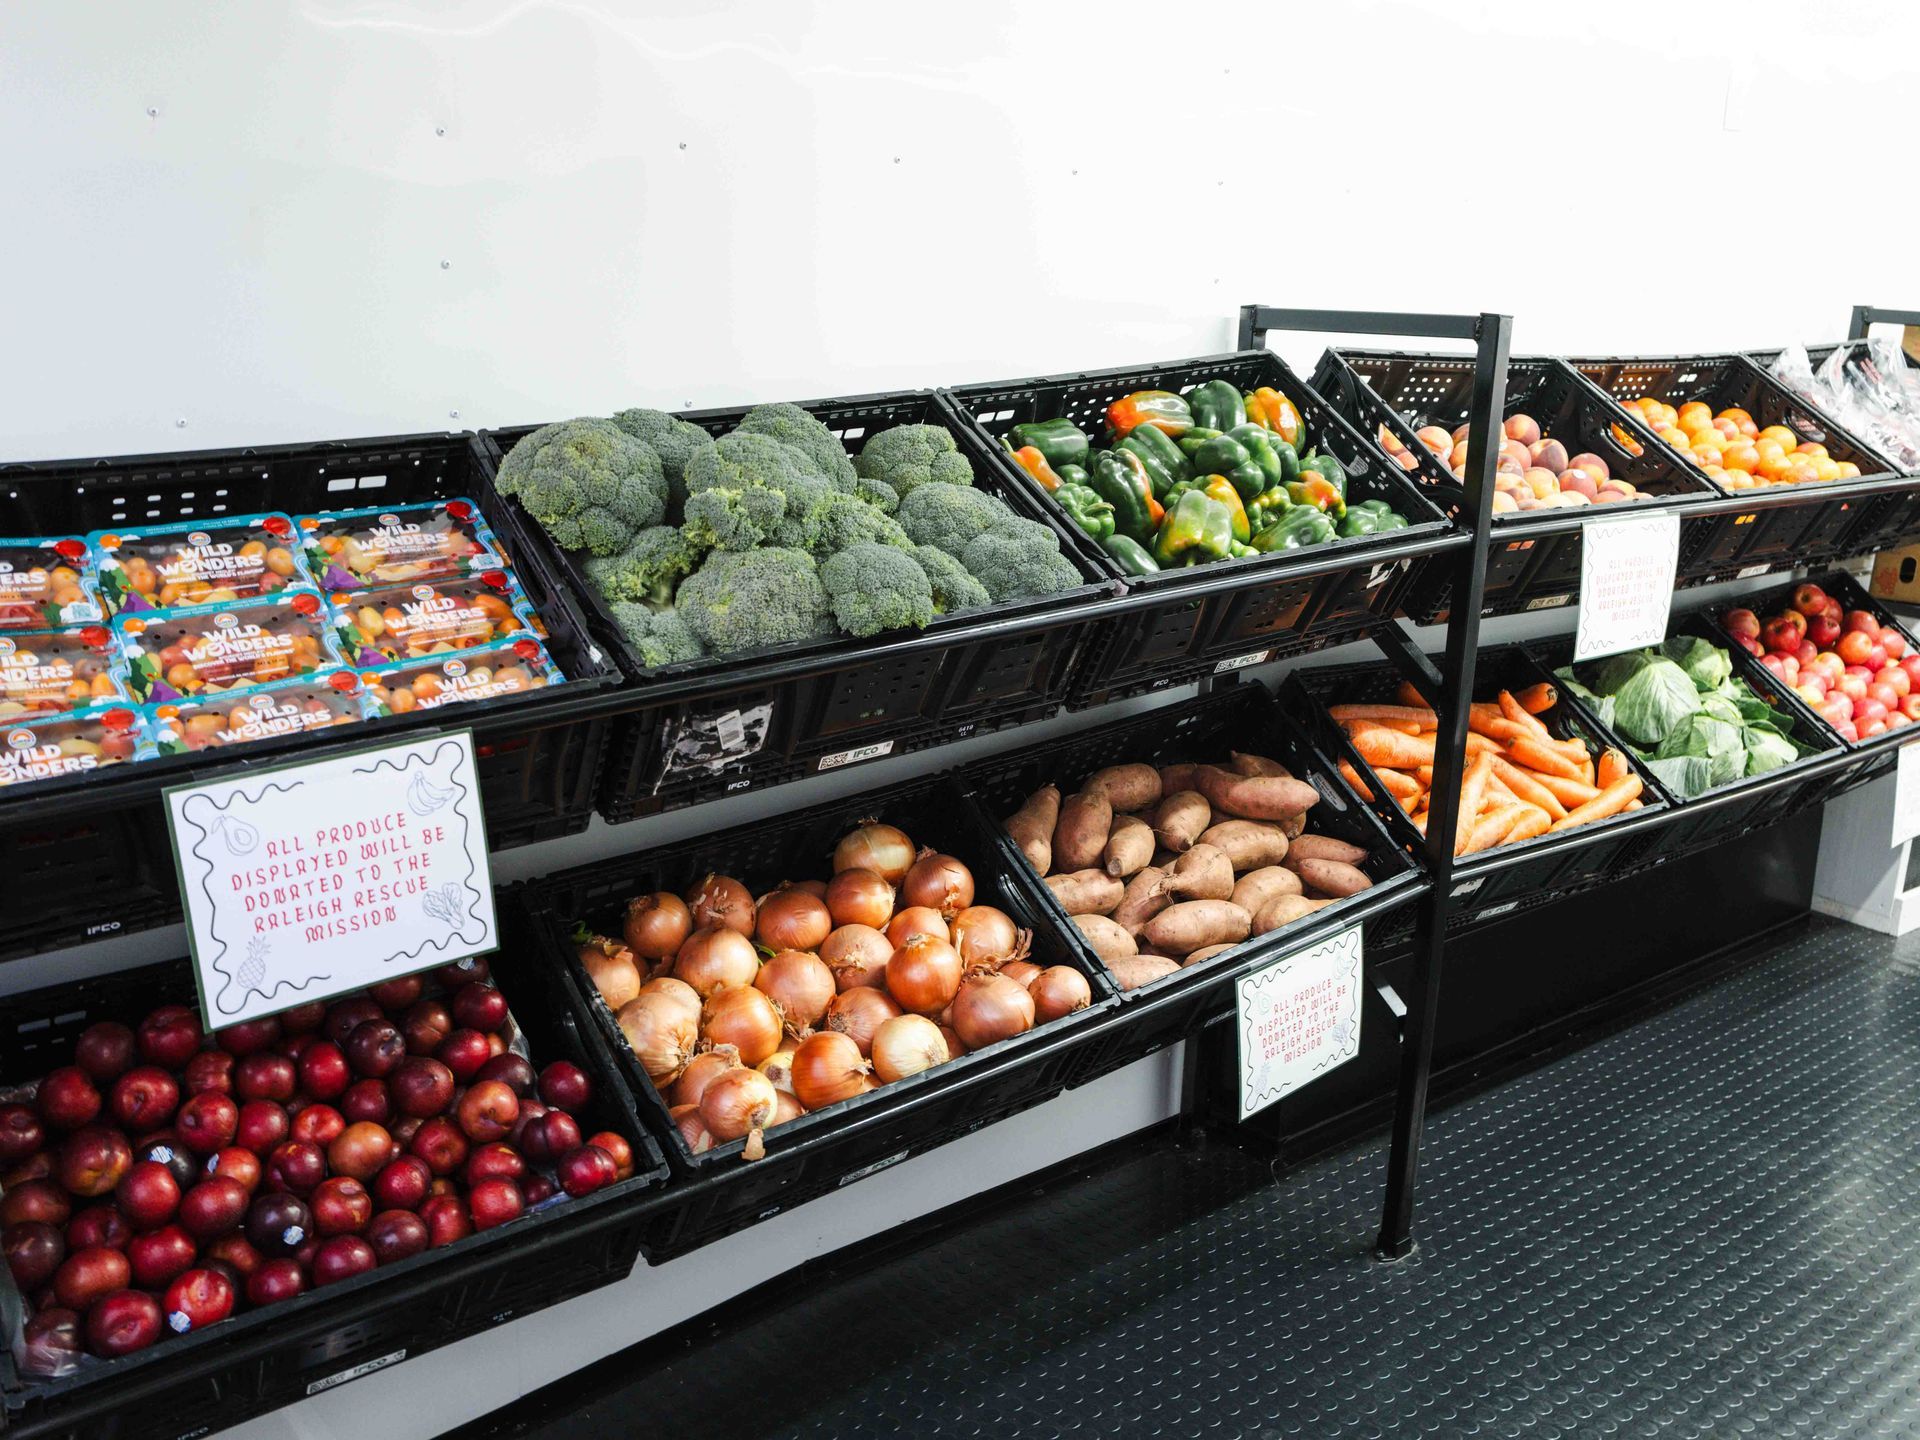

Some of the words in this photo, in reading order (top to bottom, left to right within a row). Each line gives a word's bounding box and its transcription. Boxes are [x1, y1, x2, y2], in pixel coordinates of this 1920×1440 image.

[352, 533, 449, 550] WONDERS
[369, 523, 421, 537] WILD
[176, 543, 233, 560] WILD
[156, 553, 264, 576] WONDERS
[384, 607, 485, 629] WONDERS
[401, 597, 456, 614] WILD
[202, 624, 261, 643] WILD
[0, 654, 39, 667] ILD
[182, 634, 293, 662] WONDERS
[418, 678, 520, 709] WONDERS
[434, 672, 489, 691] WILD
[216, 709, 332, 742] WONDERS
[238, 704, 298, 723] WILD
[0, 744, 62, 767] WILD
[853, 746, 879, 758] IFCO
[0, 754, 98, 783] ONDERS
[728, 780, 750, 791] IFCO
[266, 836, 304, 859] ALL
[316, 812, 407, 847] PRODUCE
[231, 849, 348, 891] DISPLAYED
[360, 835, 412, 861] WILL
[423, 826, 445, 845] BE
[244, 873, 343, 912] DONATED
[356, 864, 382, 884] TO
[394, 852, 432, 874] THE
[254, 896, 343, 933] RALEIGH
[354, 875, 429, 908] RESCUE
[87, 921, 121, 935] IFCO
[305, 905, 397, 943] MISSION
[1274, 999, 1289, 1015] ALL
[1294, 978, 1332, 1005] PRODUCE
[1258, 1004, 1307, 1036] DISPLAYED
[1311, 992, 1332, 1010] WILL
[1336, 984, 1347, 998] BE
[1262, 1019, 1303, 1048] DONATED
[1308, 1012, 1319, 1025] TO
[1323, 1001, 1339, 1017] THE
[1264, 1033, 1301, 1061] RALEIGH
[1306, 1015, 1337, 1040] RESCUE
[1284, 1036, 1322, 1064] MISSION
